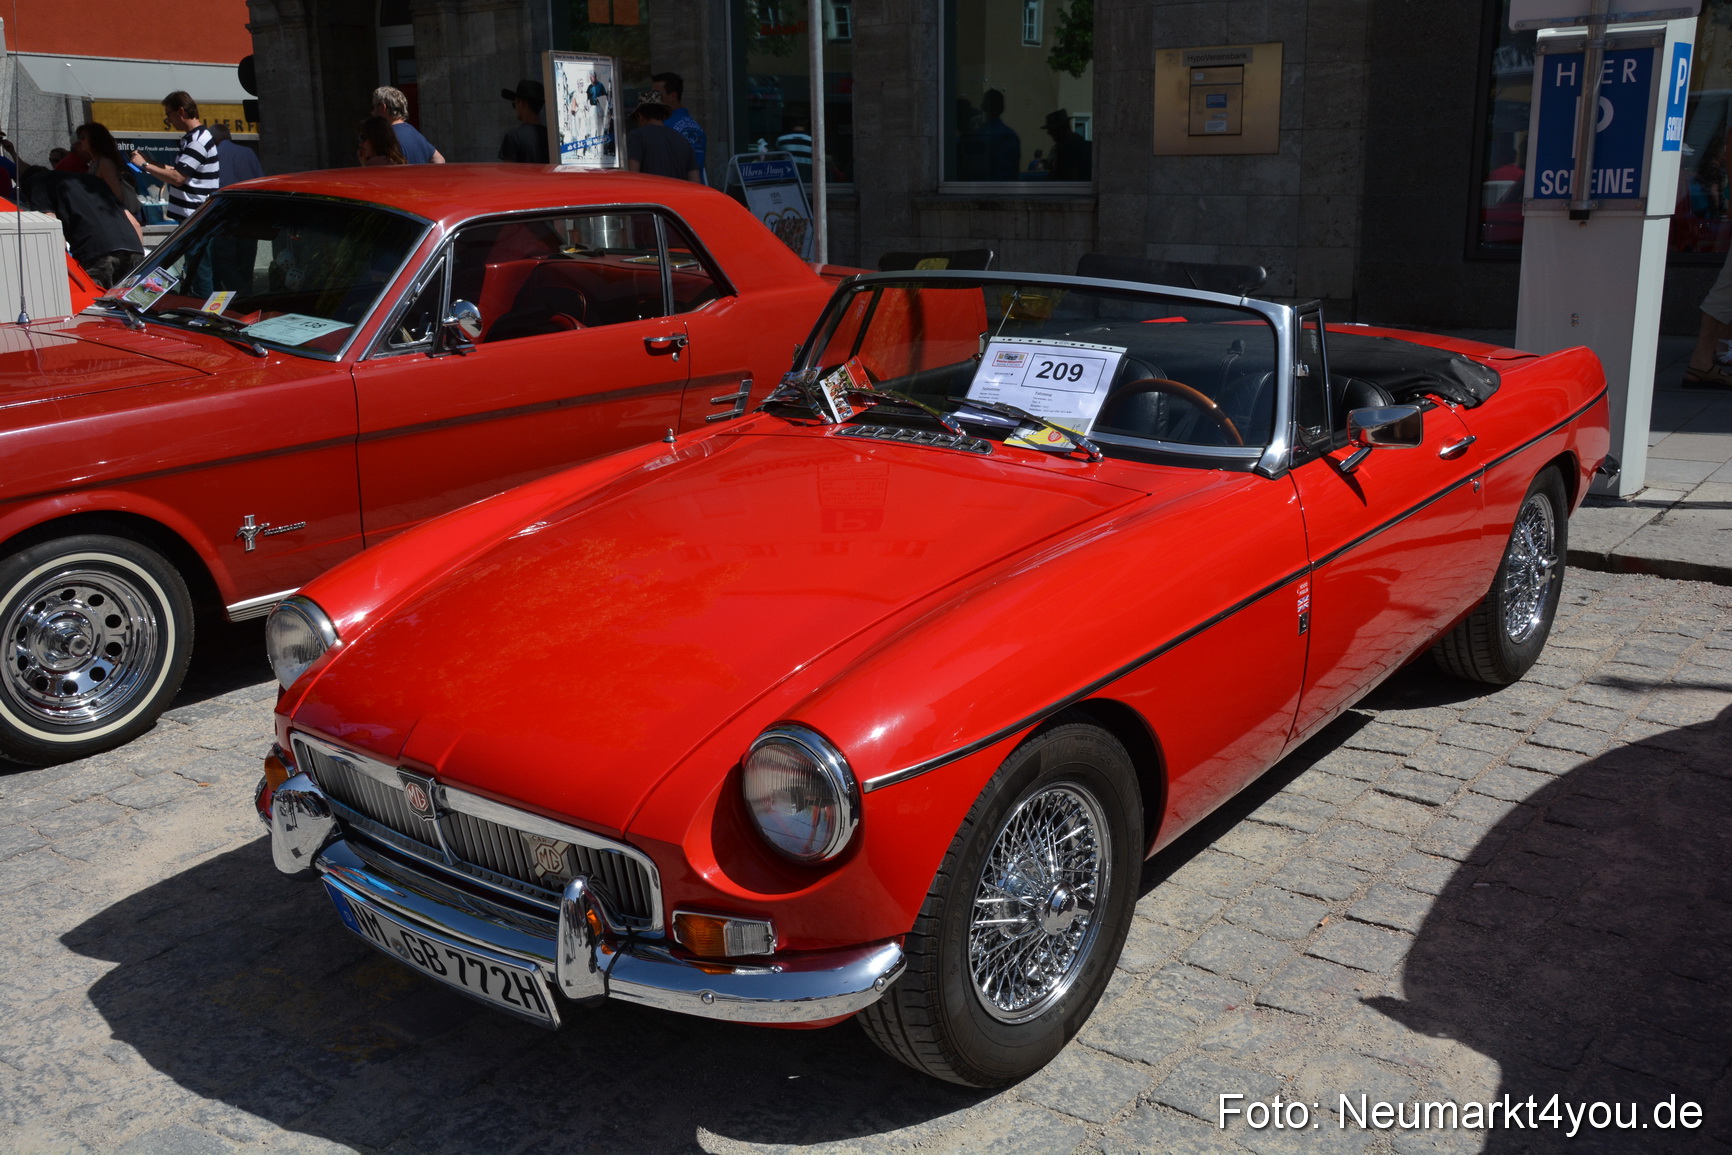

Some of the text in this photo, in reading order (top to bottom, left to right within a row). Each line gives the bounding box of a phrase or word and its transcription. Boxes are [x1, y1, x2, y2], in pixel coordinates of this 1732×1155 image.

[1187, 51, 1248, 64] HypoVereinsbank
[1556, 58, 1638, 87] HER
[1673, 58, 1688, 105] P
[1540, 168, 1636, 196] SCEINE
[300, 320, 328, 330] 138
[1035, 360, 1084, 385] 209
[408, 785, 427, 809] MG
[531, 834, 547, 843] CAR
[539, 847, 560, 871] MG
[345, 897, 391, 949] NM
[400, 929, 448, 977] GB
[445, 948, 546, 1014] 772H
